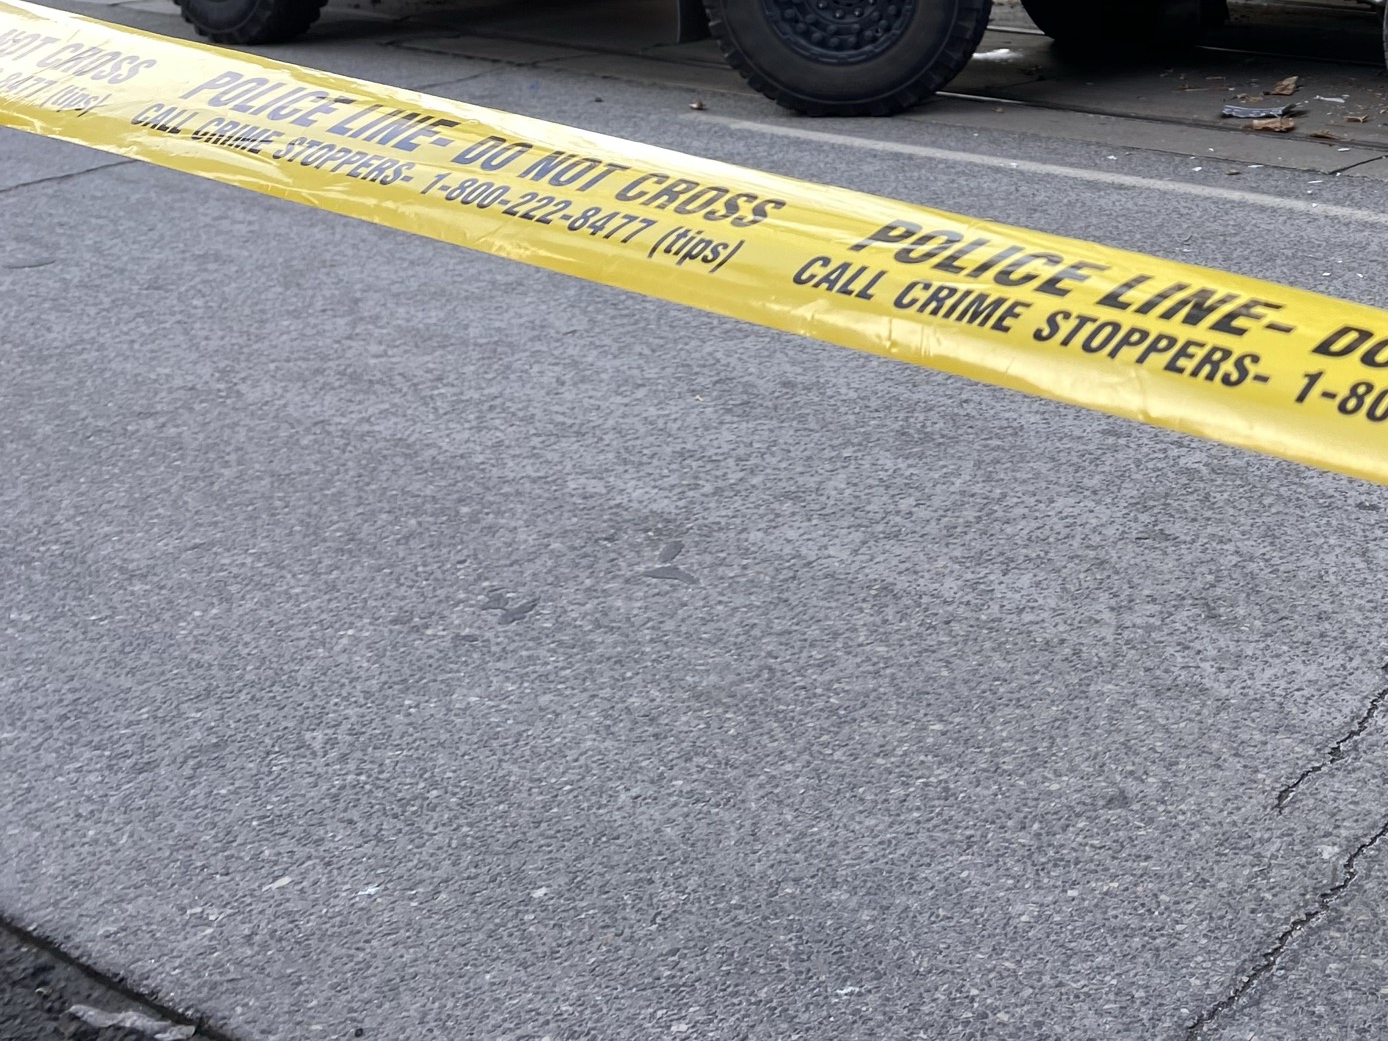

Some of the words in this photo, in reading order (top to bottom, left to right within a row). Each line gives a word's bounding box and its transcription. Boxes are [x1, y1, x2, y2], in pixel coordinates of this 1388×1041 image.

[36, 42, 157, 85] CROSS
[39, 84, 113, 118] (tips)
[130, 102, 200, 135] CALL
[190, 116, 285, 155] CRIME
[272, 135, 414, 186] STOPPERS-
[420, 171, 658, 245] 1-800-222-8477
[647, 224, 746, 274] (tips)
[180, 71, 356, 128] POLICE
[326, 102, 461, 153] LINE-
[450, 134, 534, 172] DO
[519, 150, 630, 192] NOT
[615, 172, 787, 228] CROSS
[791, 255, 890, 302] CALL
[892, 278, 1033, 334] CRIME
[1032, 310, 1273, 389] STOPPERS-
[849, 218, 1107, 298] POLICE
[1099, 273, 1298, 338] LINE-
